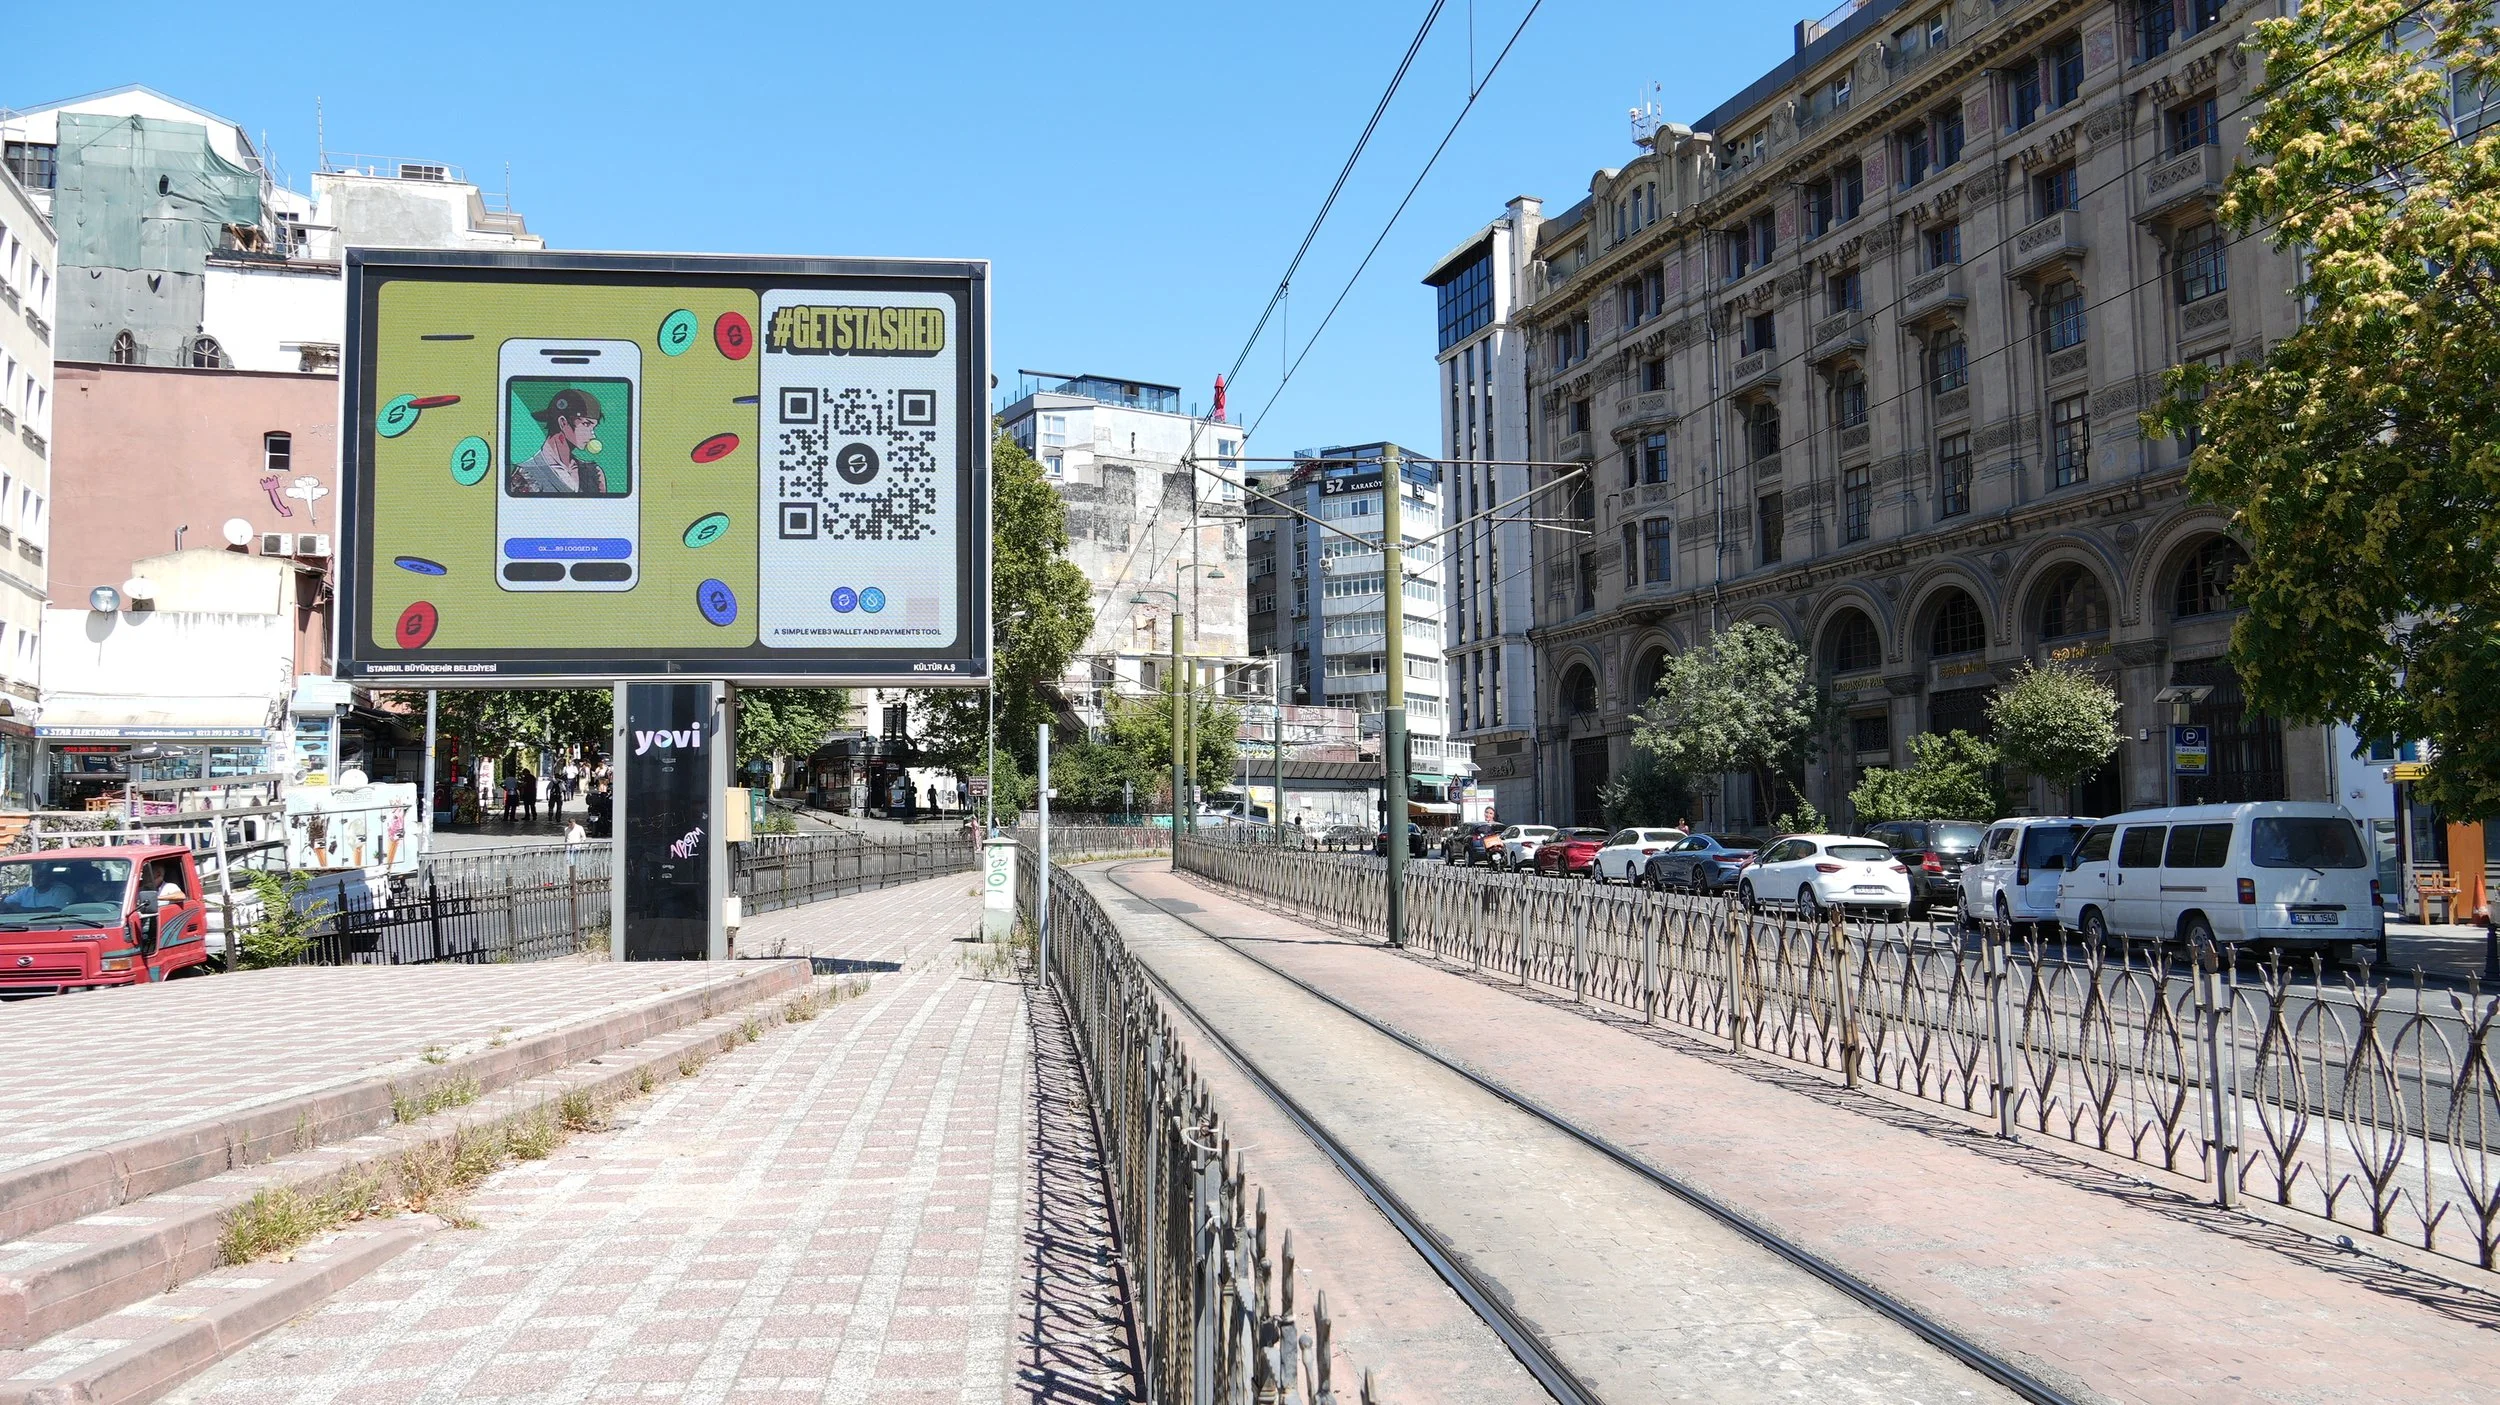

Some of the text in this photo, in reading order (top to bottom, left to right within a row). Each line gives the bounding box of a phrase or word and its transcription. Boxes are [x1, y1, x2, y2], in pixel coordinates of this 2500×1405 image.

[769, 305, 945, 353] #GETSTASHED
[1326, 479, 1383, 494] 52 KARAKÖY
[1416, 484, 1425, 497] 52
[880, 628, 921, 636] PAYMENTS
[921, 628, 942, 636] TOOL
[366, 663, 497, 674] İSTANBUL BÜYÜKŞEHİR BELEDİYESİ
[913, 663, 943, 671] KÜLTÜR
[50, 728, 72, 736] STAR
[635, 722, 701, 756] yovi
